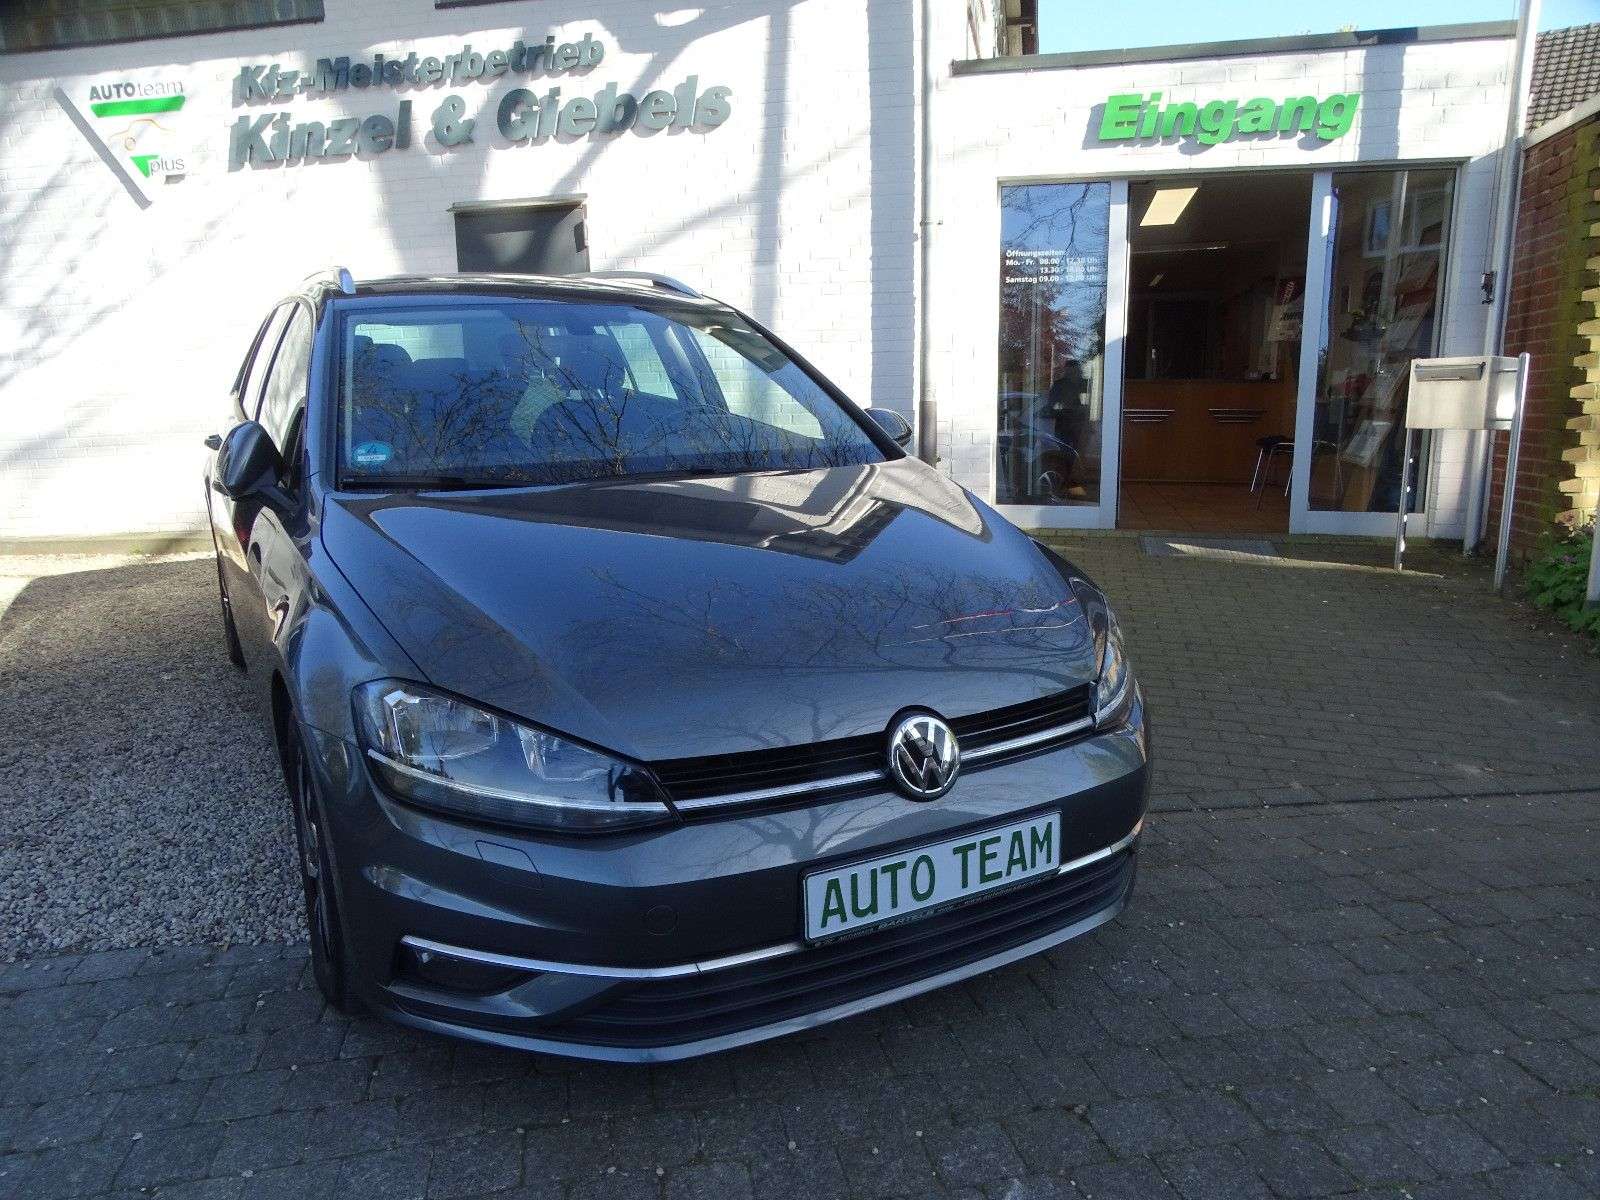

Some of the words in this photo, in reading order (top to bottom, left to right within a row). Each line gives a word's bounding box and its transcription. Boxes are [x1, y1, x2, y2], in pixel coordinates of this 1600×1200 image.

[236, 32, 605, 98] Kfz-Meisterbetrieb
[231, 99, 412, 168] Kinzel
[432, 94, 475, 149] &
[496, 74, 733, 142] Giebels
[1098, 92, 1361, 145] Eingang
[150, 157, 185, 176] plus
[820, 854, 936, 929] AUTO
[952, 821, 1053, 889] TEAM
